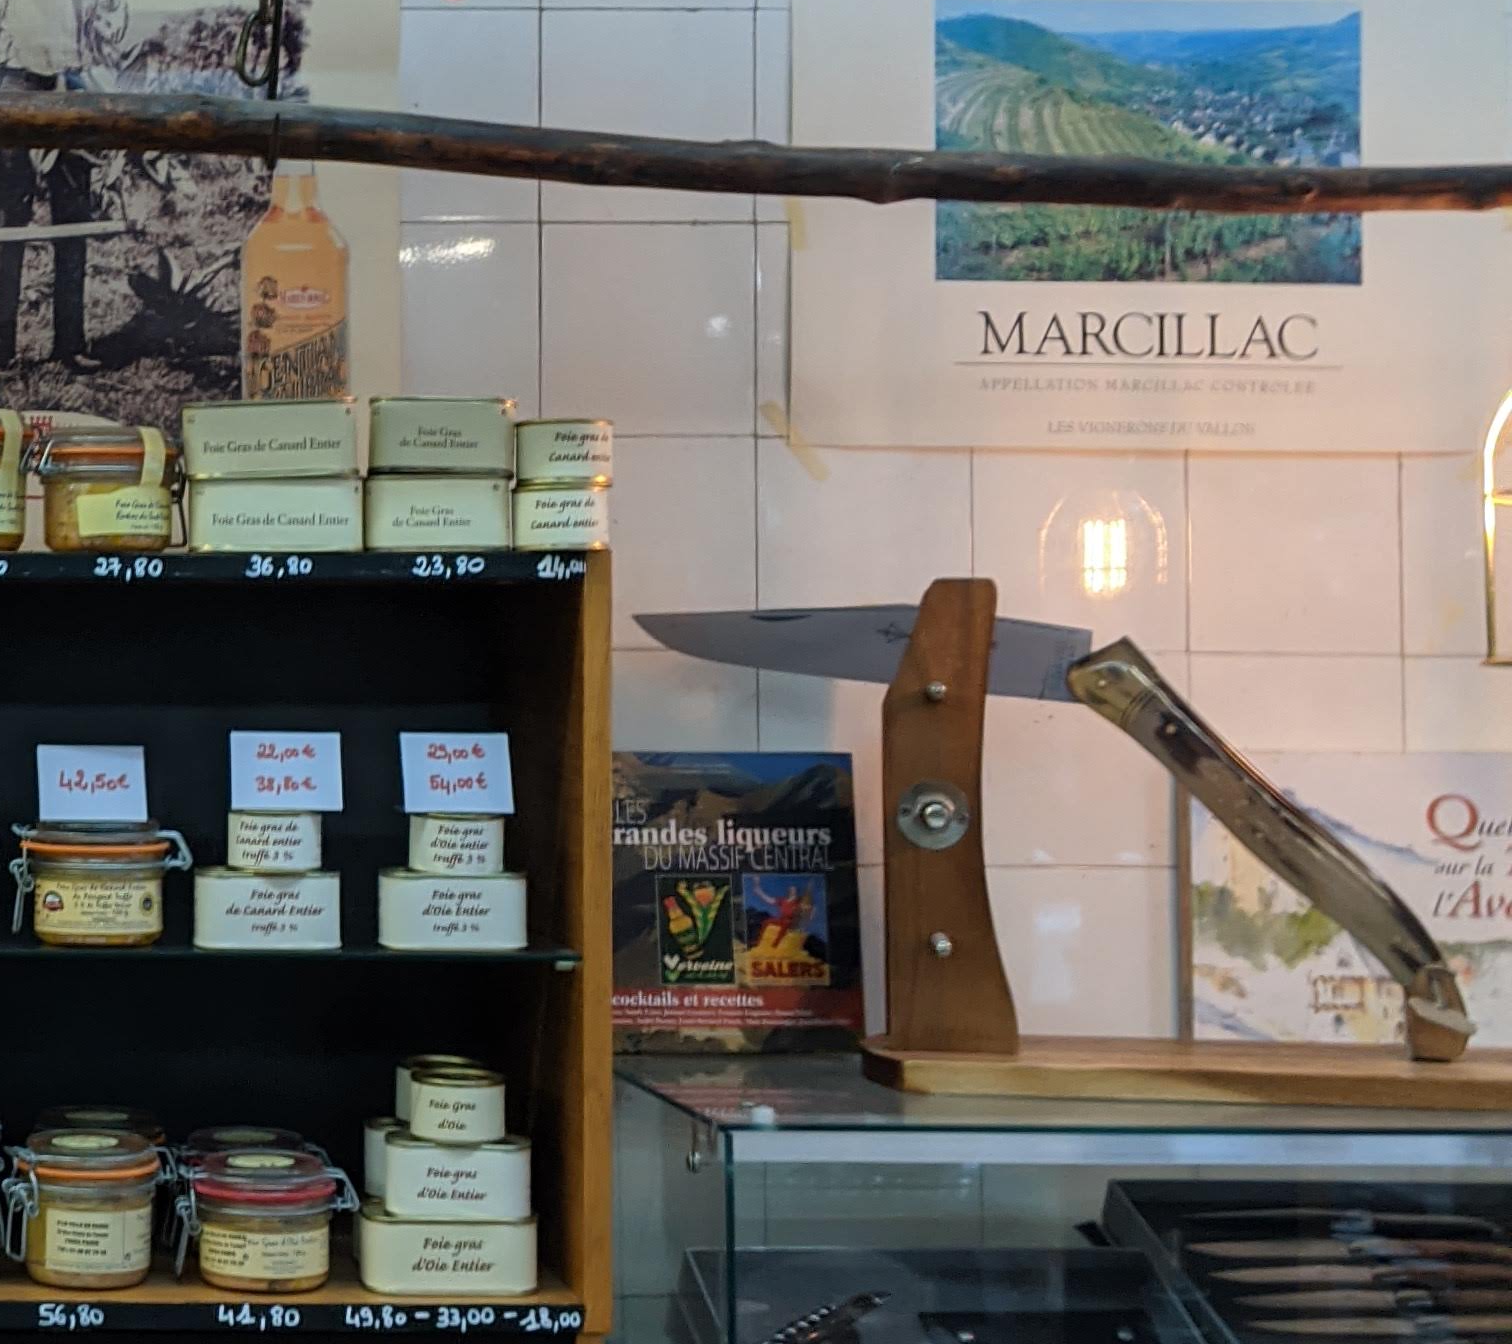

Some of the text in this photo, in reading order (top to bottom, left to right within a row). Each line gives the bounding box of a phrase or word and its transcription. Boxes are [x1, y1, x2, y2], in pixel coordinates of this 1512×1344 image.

[977, 310, 1319, 361] MARCILLAC
[978, 377, 1099, 393] APPELLATION
[1104, 379, 1202, 394] MARCILLAC
[93, 557, 164, 582] 27,80
[244, 556, 313, 579] 36,80
[411, 556, 486, 580] 23,80
[614, 801, 647, 825] LES
[612, 819, 832, 852] randes liqueurs
[643, 846, 835, 871] DU MASSIF CENTRAL
[1434, 855, 1493, 876] sur la
[250, 889, 300, 904] Foie gras
[431, 889, 483, 905] Foie gras
[225, 904, 325, 916] de Canard Entier
[751, 959, 827, 979] SALERS
[612, 990, 764, 1008] cocktails et recettes
[437, 1119, 467, 1131] d'Oie
[426, 1167, 478, 1183] Foie gras
[416, 1188, 488, 1201] d'Oie Entier
[422, 1236, 483, 1253] Foie gras
[411, 1258, 496, 1273] d'Oie Entier
[38, 1302, 105, 1331] 56,80
[217, 1305, 301, 1332] 41,80
